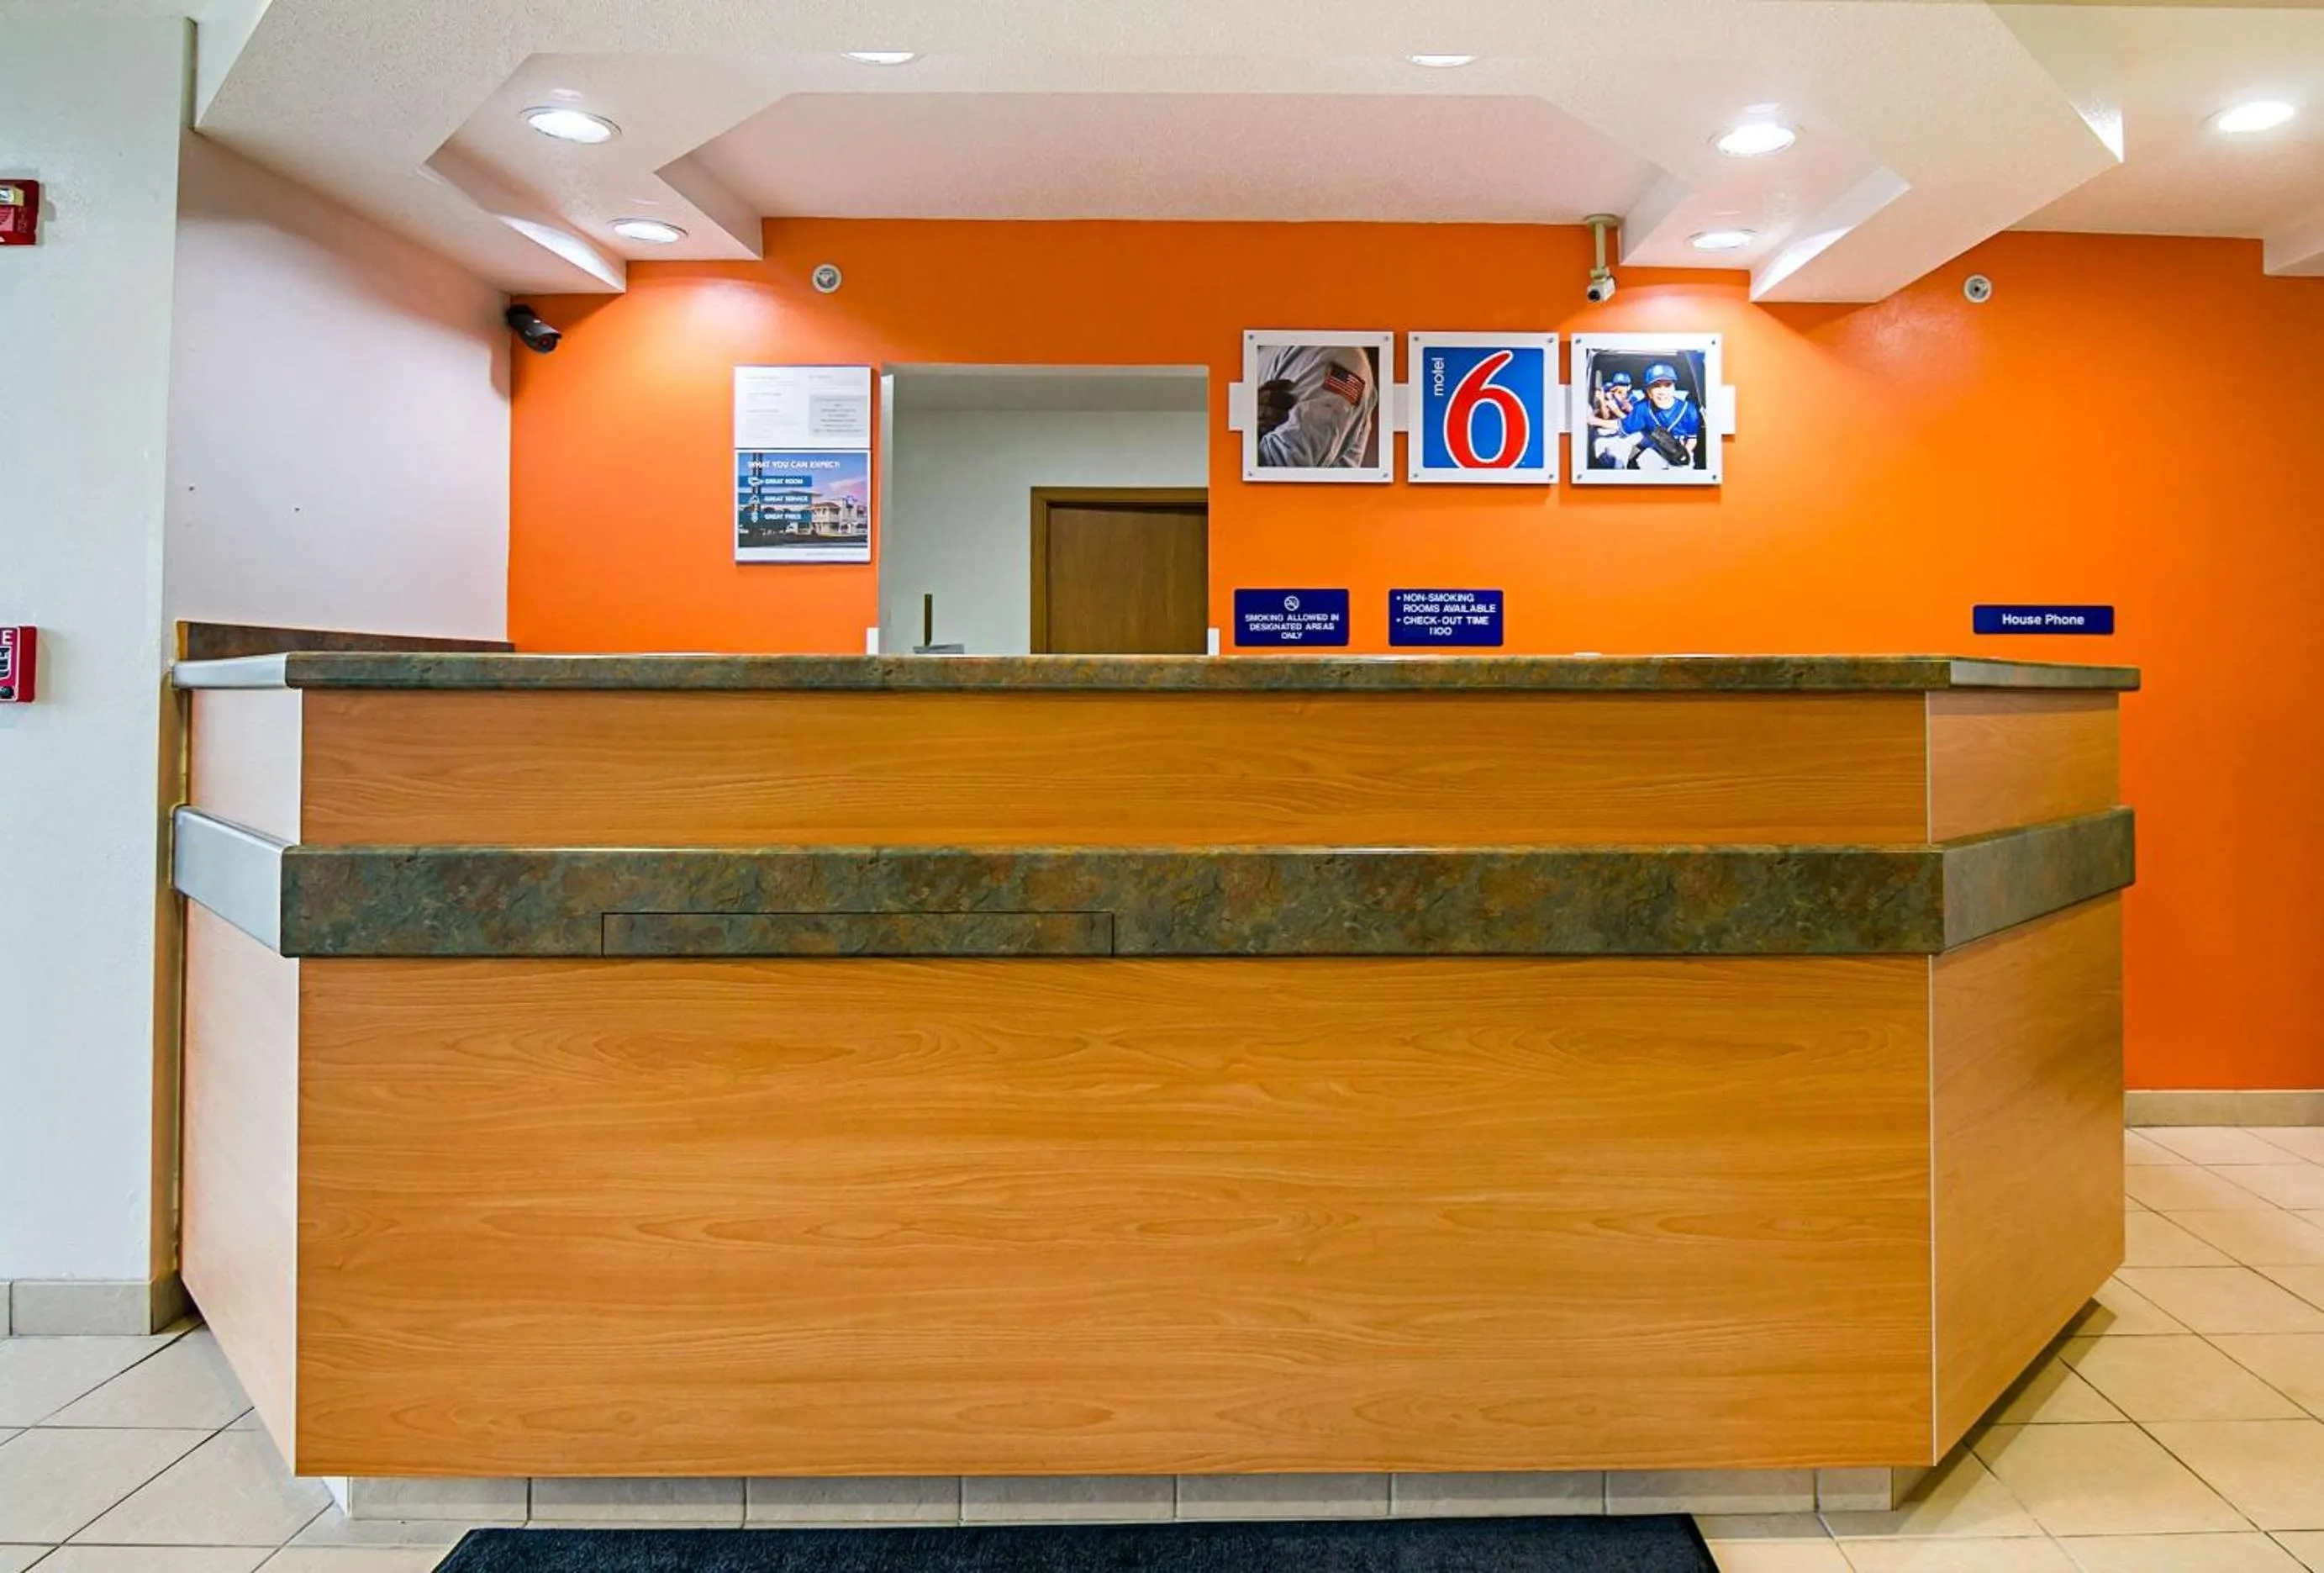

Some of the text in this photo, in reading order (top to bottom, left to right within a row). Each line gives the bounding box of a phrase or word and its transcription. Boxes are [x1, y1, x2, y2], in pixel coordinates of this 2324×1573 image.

[1431, 350, 1530, 469] motel 6
[747, 461, 770, 469] WHAT
[1403, 593, 1475, 602] NON-SMOKING
[1403, 604, 1497, 613] ROOMS AVAILABLE
[1245, 614, 1284, 622] SMOKING
[1331, 613, 1340, 621] IN
[1403, 615, 1489, 626] CHECK-OUT TIME
[2002, 614, 2085, 625] House Phone
[1249, 622, 1335, 631] DESIGNATED AREAS
[1280, 631, 1303, 640] ONLY
